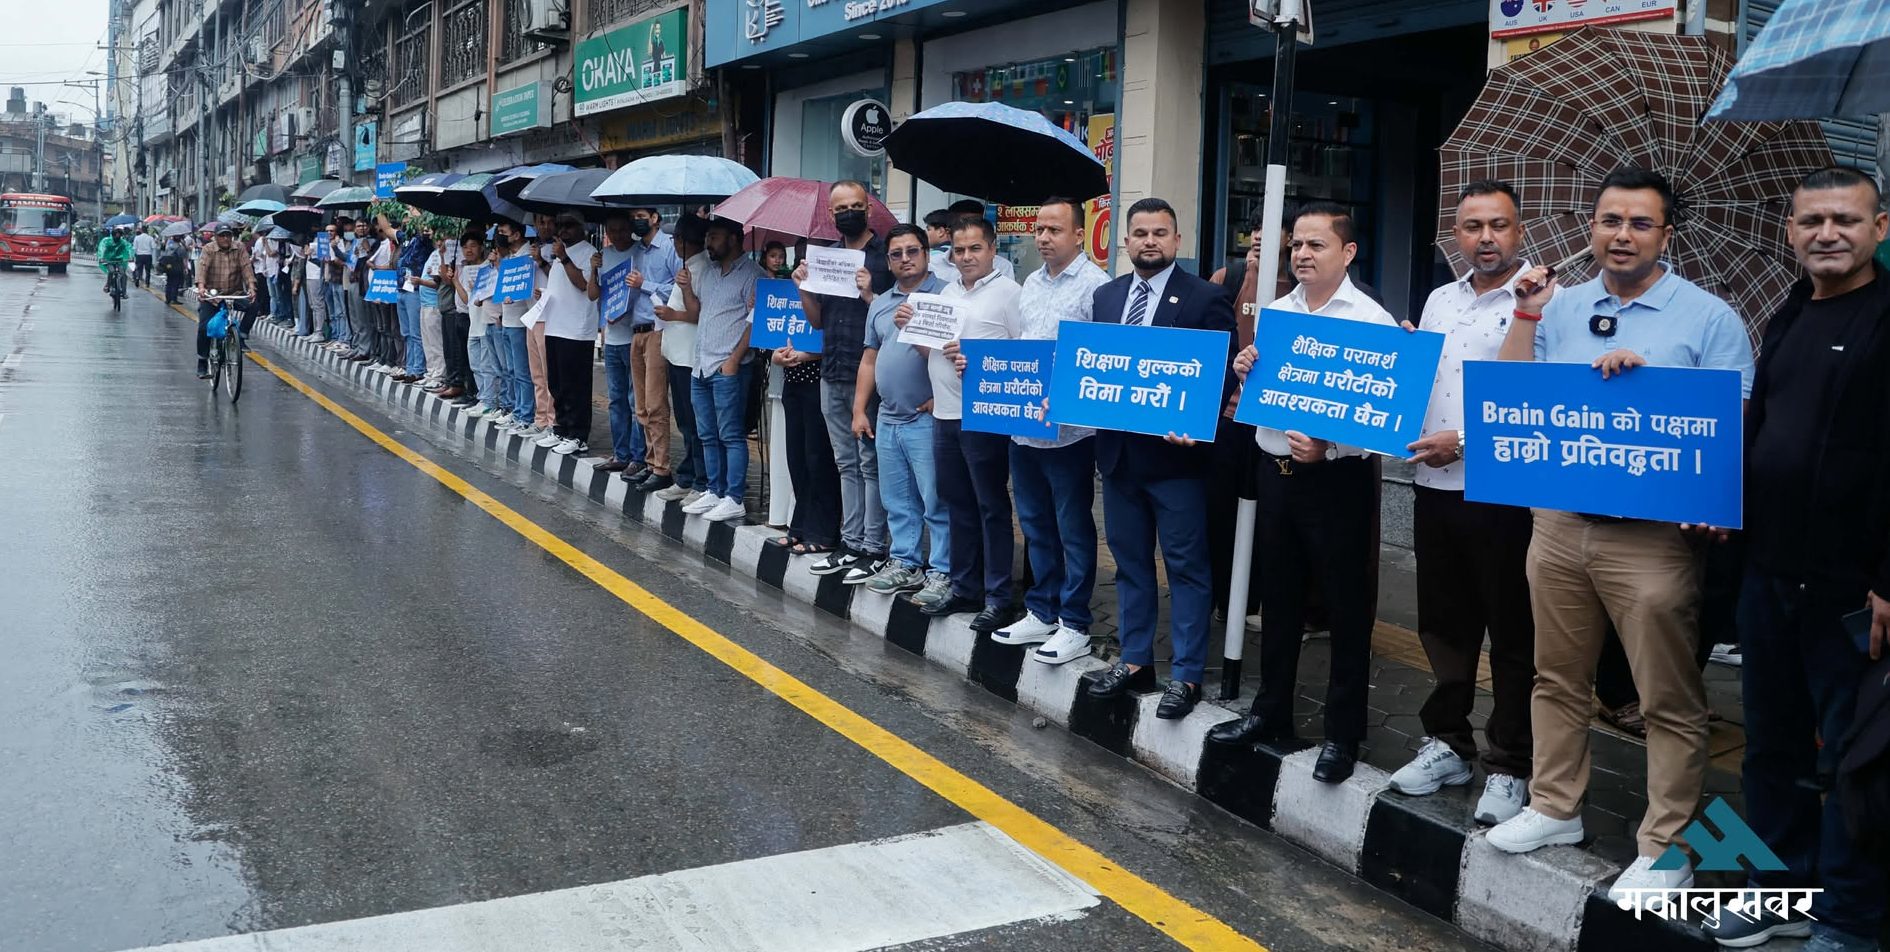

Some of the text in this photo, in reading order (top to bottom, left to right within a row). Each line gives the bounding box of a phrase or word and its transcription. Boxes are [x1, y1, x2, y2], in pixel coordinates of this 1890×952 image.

[844, 1, 877, 20] Since
[1605, 5, 1621, 14] CAN
[1641, 0, 1657, 8] EUR
[1505, 19, 1518, 27] AUS
[1538, 15, 1548, 23] UK
[582, 48, 636, 92] OKAYA
[861, 123, 884, 134] Apple
[997, 219, 1027, 231] आकर्षक
[767, 294, 788, 310] शिक्षा
[1242, 302, 1257, 316] ST
[767, 315, 786, 332] खर्च
[1292, 335, 1398, 370] शैक्षिक परामर्श
[982, 356, 1039, 374] शैक्षिक परामर्श
[1075, 347, 1202, 378] शिक्षण शुल्कको
[979, 377, 1043, 396] क्षेत्रमा धरौटीको
[1278, 362, 1398, 400] क्षेत्रमा धरौटीको
[1079, 376, 1123, 403] विमा
[1130, 382, 1172, 408] गरौं
[972, 401, 1021, 418] आवश्यकता
[1259, 389, 1350, 420] आवश्यकता
[1353, 402, 1389, 428] छैन
[1482, 401, 1717, 439] Brain Gain को पक्षमा
[1492, 431, 1551, 463] हाम्रो
